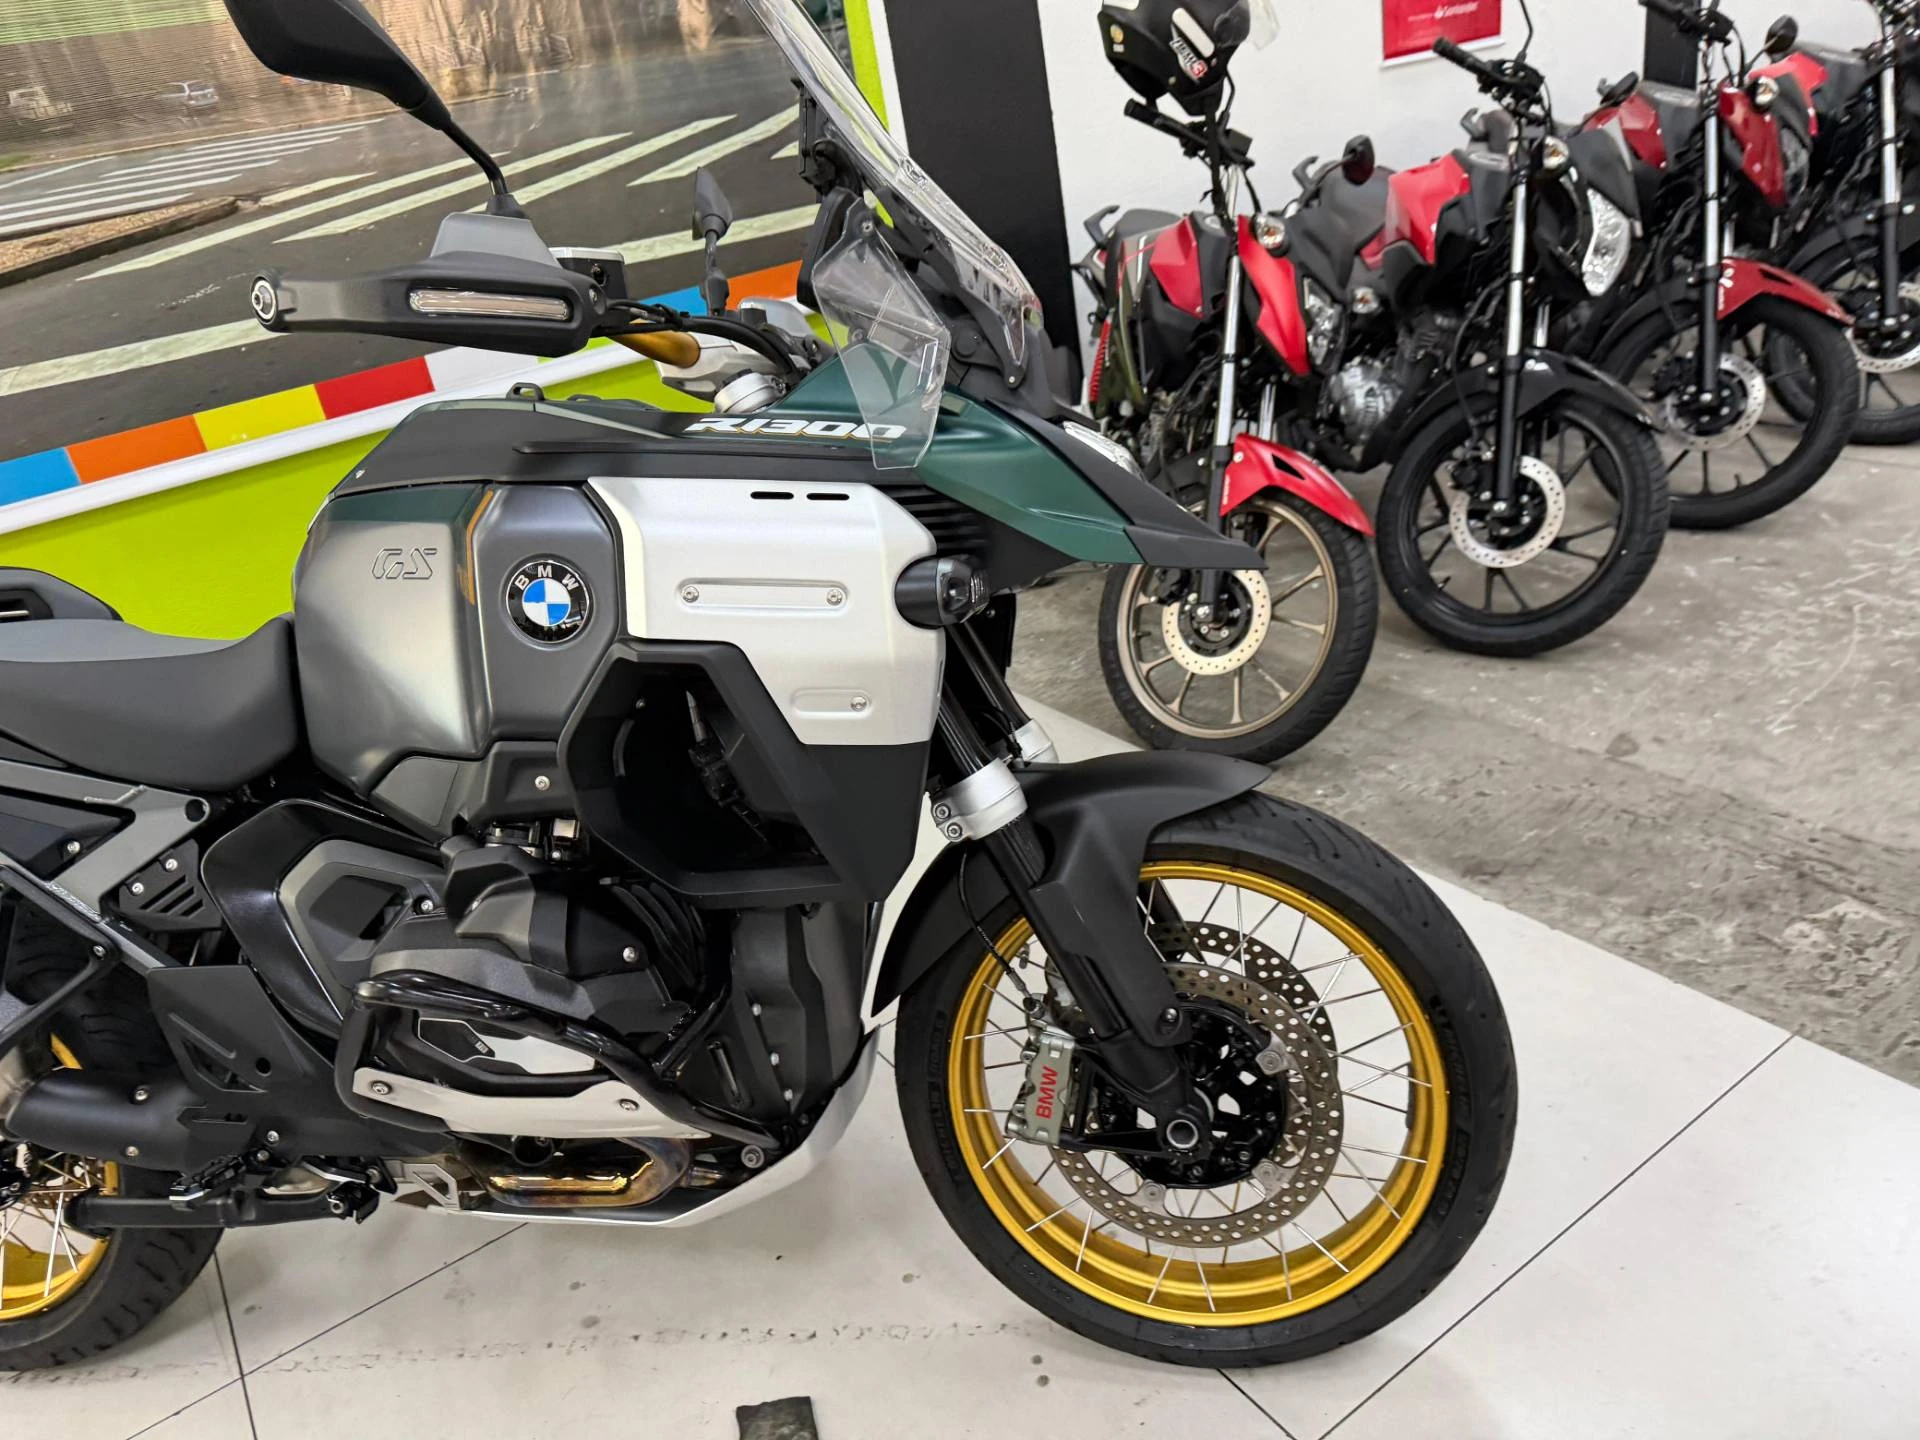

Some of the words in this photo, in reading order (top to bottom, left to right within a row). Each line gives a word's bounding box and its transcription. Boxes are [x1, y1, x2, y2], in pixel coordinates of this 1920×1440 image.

[683, 417, 907, 440] R1300
[371, 548, 437, 580] GS
[514, 564, 579, 591] BMW
[1035, 1065, 1058, 1119] BMW
